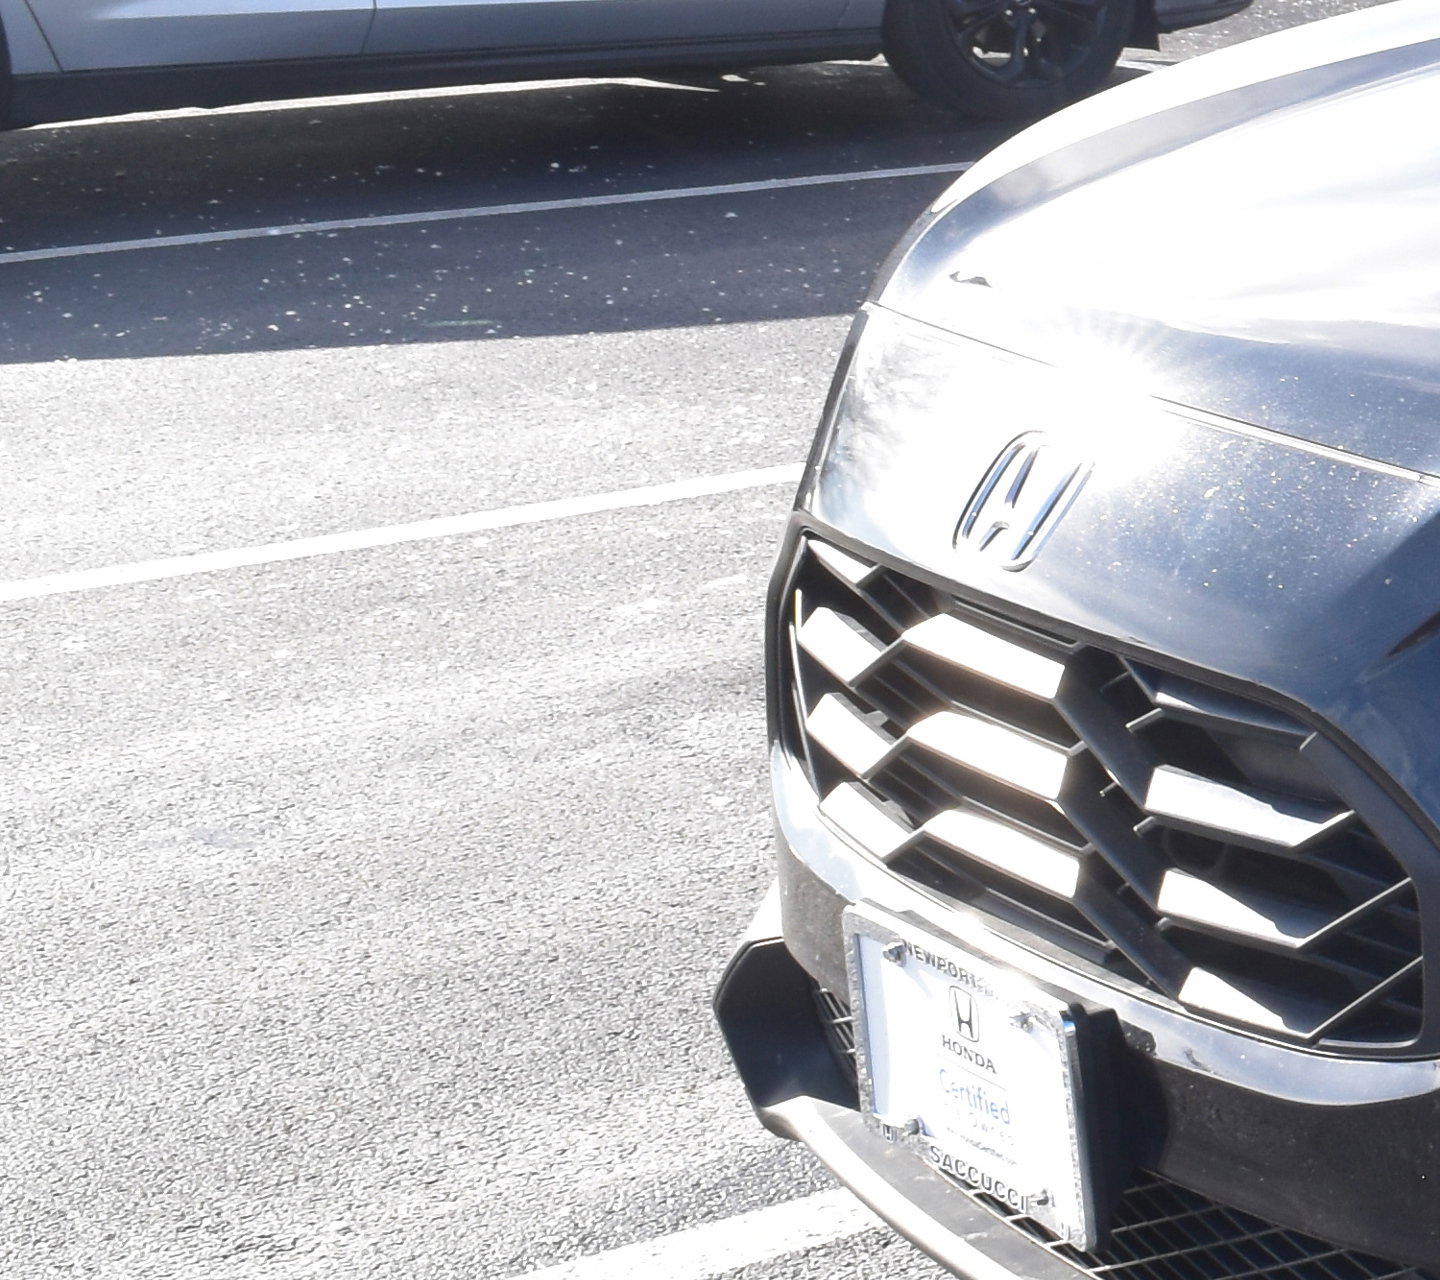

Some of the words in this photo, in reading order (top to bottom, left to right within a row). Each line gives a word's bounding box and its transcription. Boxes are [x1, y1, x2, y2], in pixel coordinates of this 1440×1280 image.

[942, 1034, 997, 1074] HONDA
[940, 1068, 1010, 1125] Certified
[929, 1144, 1028, 1212] SACCUCCI
